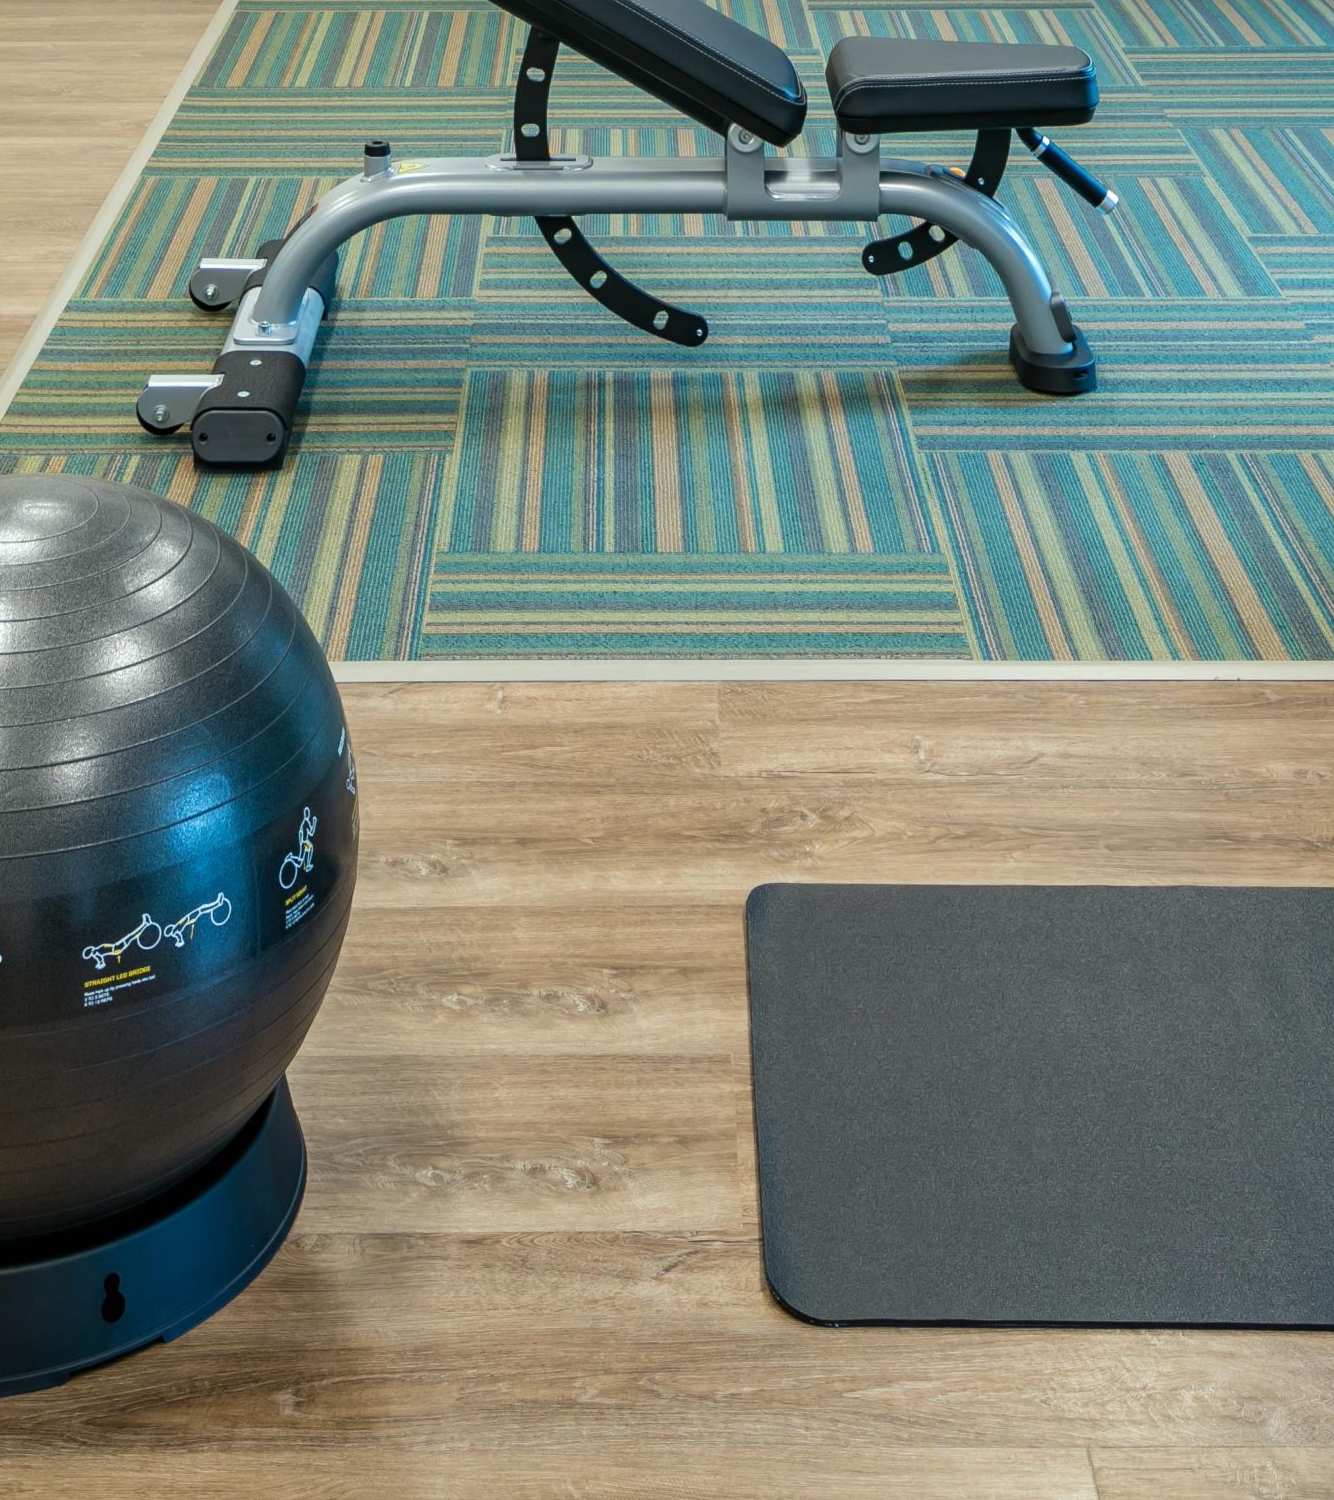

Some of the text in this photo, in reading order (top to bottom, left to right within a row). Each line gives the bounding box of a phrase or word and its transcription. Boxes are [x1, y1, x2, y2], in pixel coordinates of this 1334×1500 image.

[84, 975, 116, 988] STRAIGHT
[116, 972, 128, 980] LEG
[128, 965, 151, 976] BRIDGE
